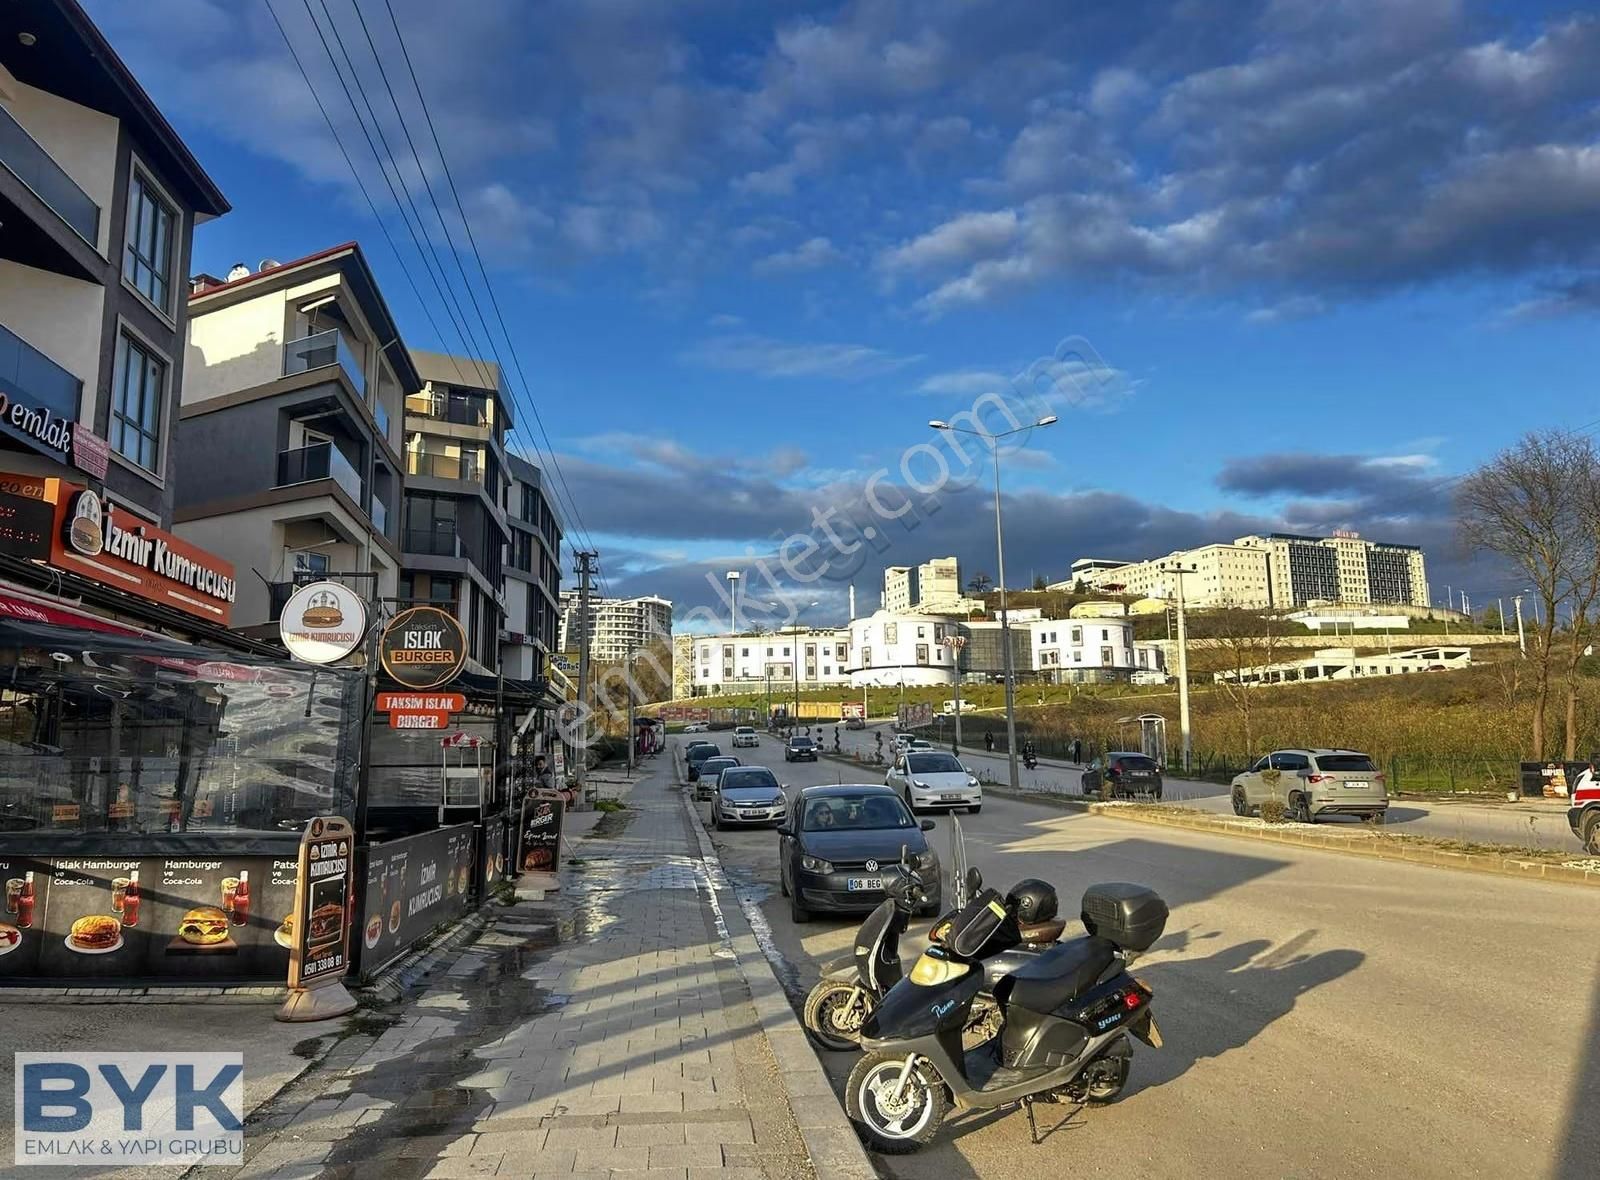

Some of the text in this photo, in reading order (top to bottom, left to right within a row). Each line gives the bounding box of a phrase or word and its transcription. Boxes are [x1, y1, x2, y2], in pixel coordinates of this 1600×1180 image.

[11, 403, 71, 453] emlak
[104, 502, 237, 603] İzmir Kumrucusu
[404, 630, 442, 649] ISLAK
[394, 651, 452, 662] BURGER
[385, 694, 454, 710] TAKSİM ISLAK
[397, 715, 439, 729] BURGER
[56, 860, 141, 871] Islak Hamburger
[164, 860, 222, 871] Hamburger
[54, 878, 94, 886] Coca-Cola
[853, 879, 881, 889] 06 BEG
[335, 954, 342, 966] 81
